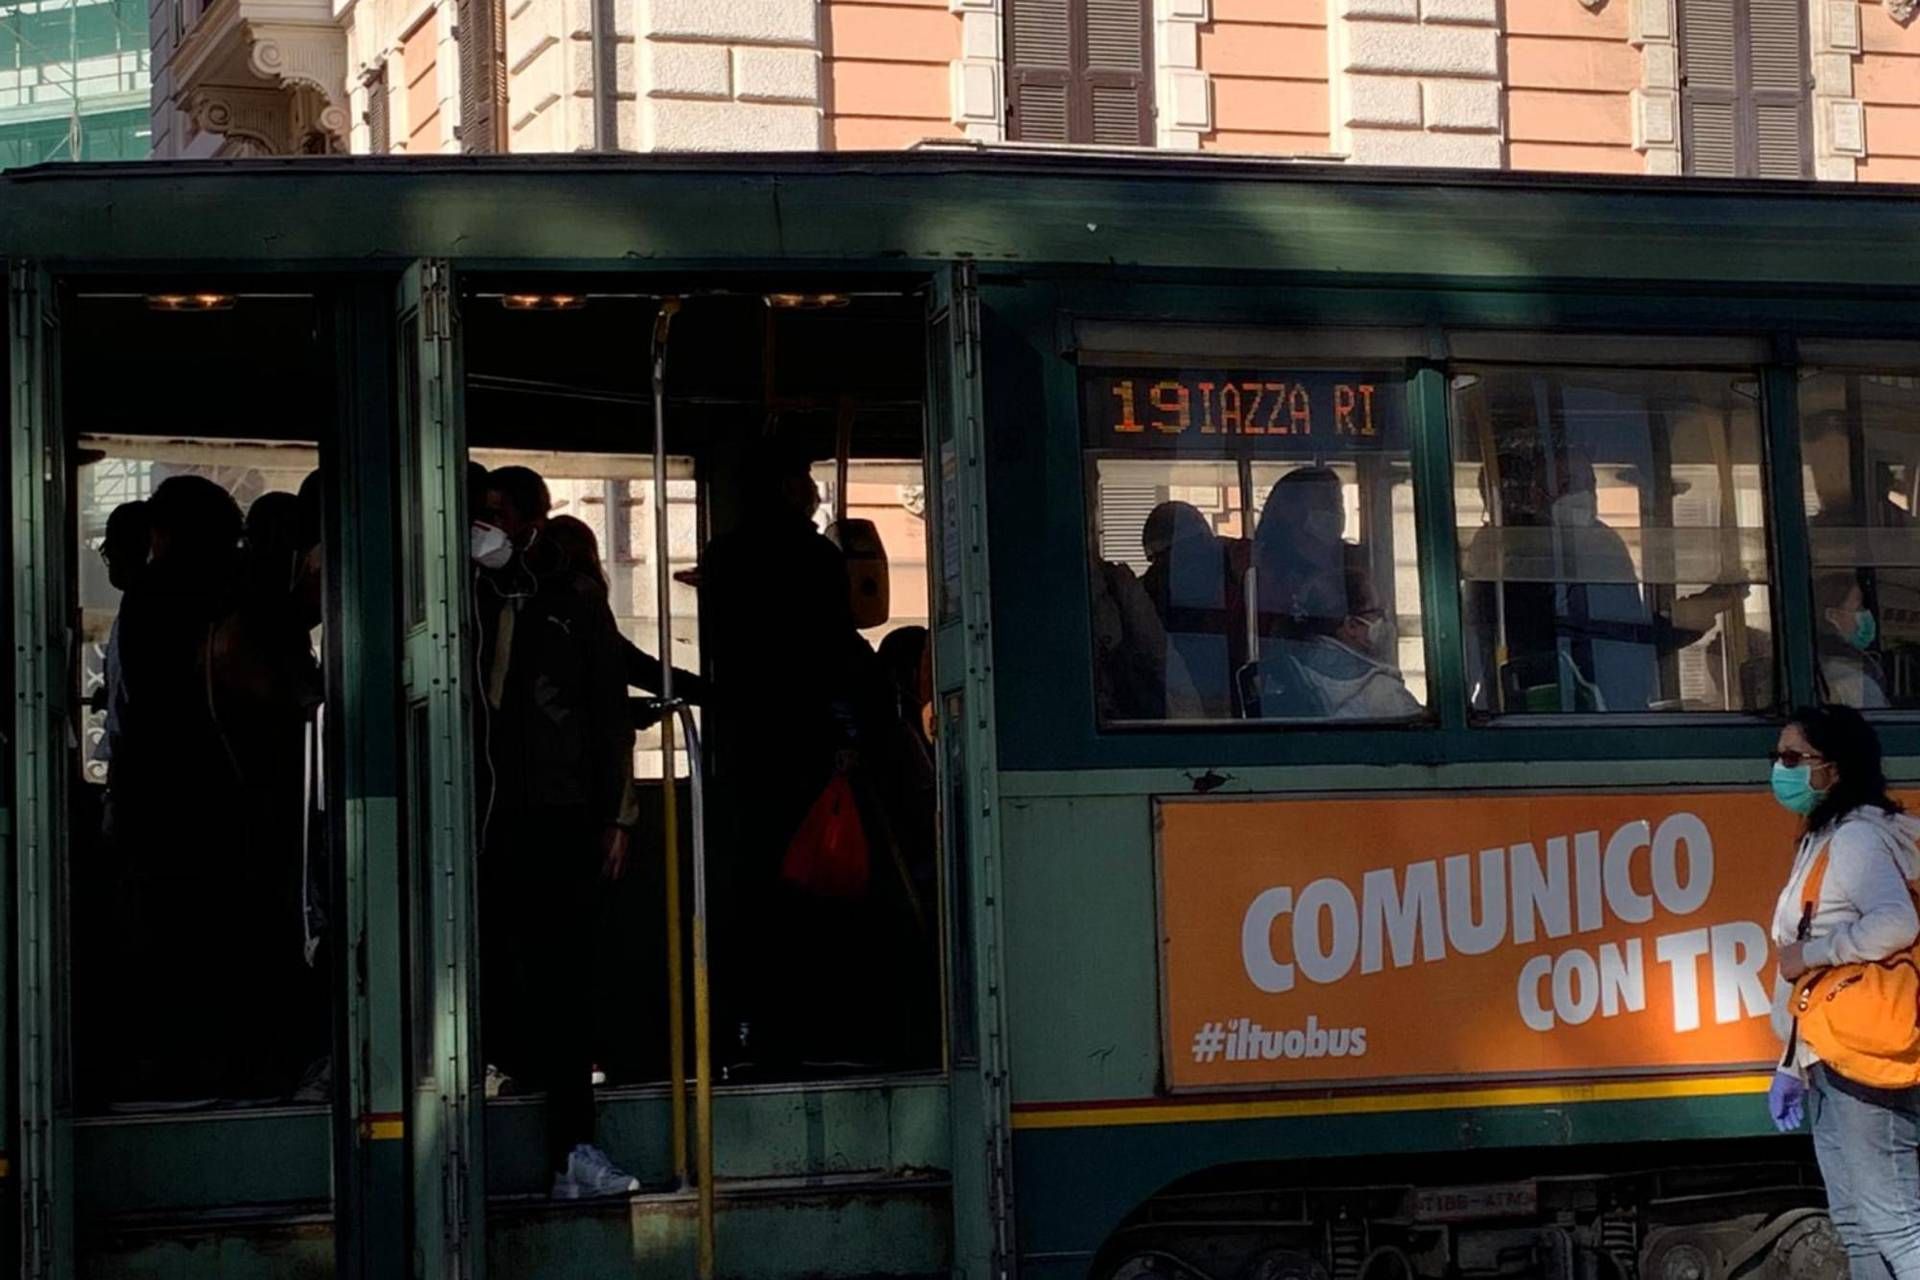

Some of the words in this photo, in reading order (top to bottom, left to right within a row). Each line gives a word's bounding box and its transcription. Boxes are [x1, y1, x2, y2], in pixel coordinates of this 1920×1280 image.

[1112, 380, 1192, 434] 19
[1199, 382, 1311, 435] IAZZA
[1334, 383, 1377, 437] RI
[1241, 811, 1715, 994] COMUNICO
[1517, 937, 1646, 1032] CON
[1656, 920, 1778, 1034] TR
[1191, 1014, 1368, 1063] #iltuobus
